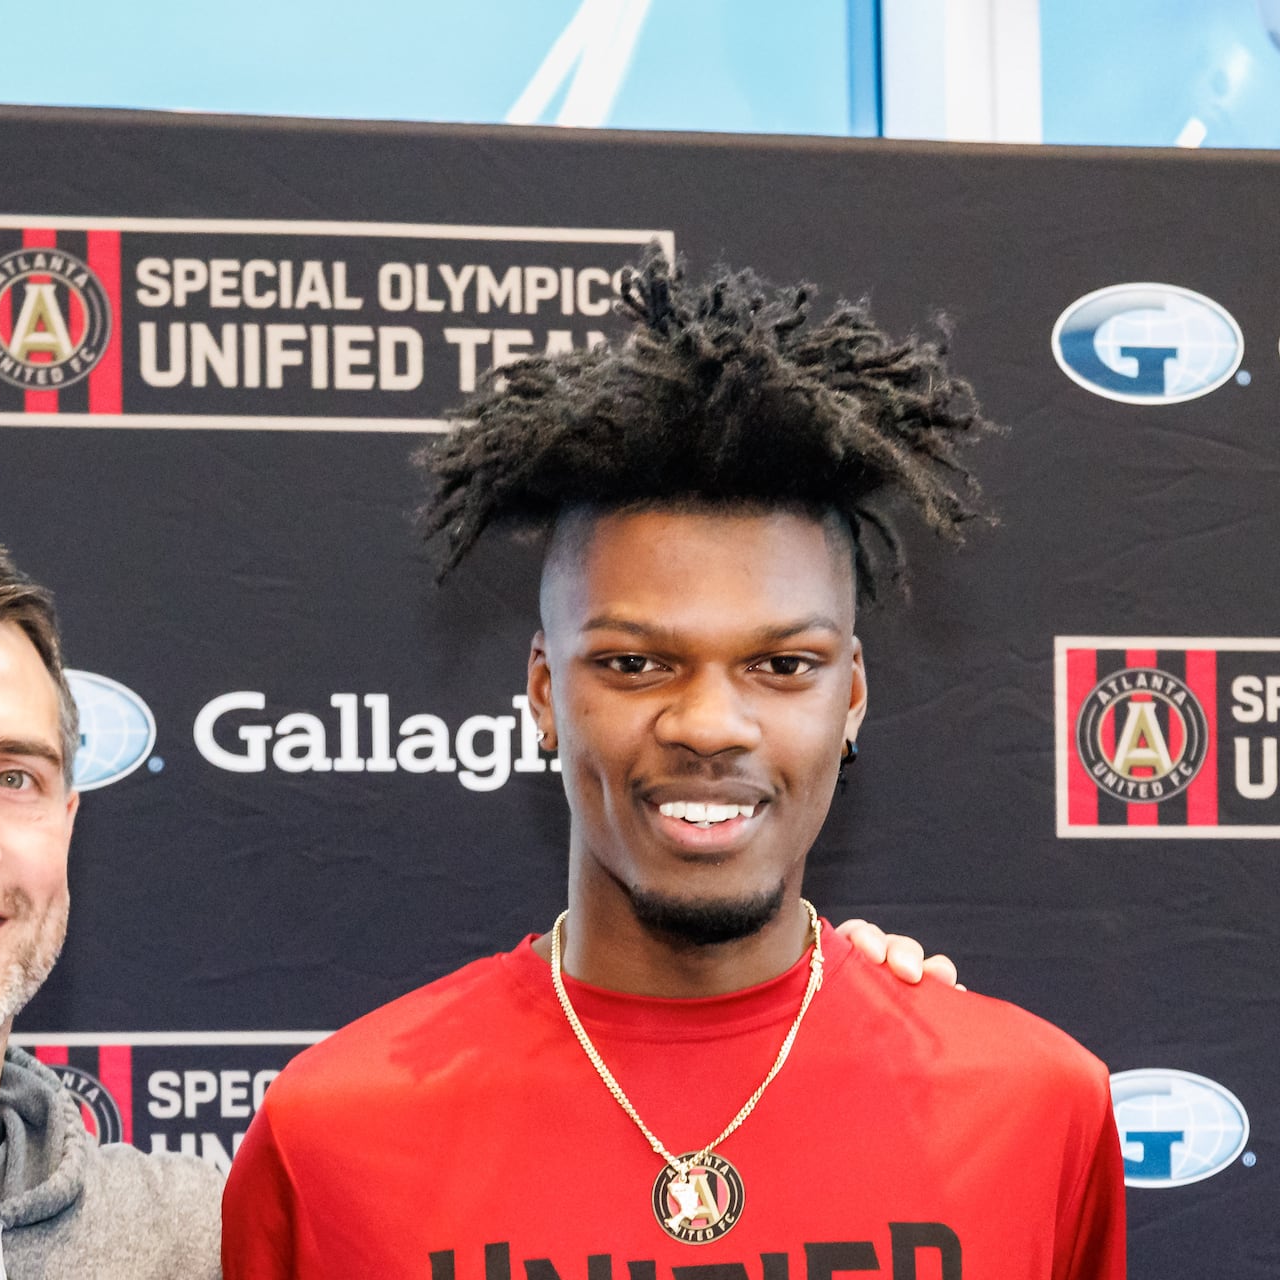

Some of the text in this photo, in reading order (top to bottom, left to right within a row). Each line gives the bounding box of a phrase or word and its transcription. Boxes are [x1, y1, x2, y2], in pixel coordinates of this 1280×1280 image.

[135, 257, 363, 311] SPECIAL
[69, 347, 96, 374] FC
[139, 321, 424, 392] UNIFIED
[1097, 672, 1186, 705] ATLANTA
[1092, 761, 1193, 798] UNITED FC
